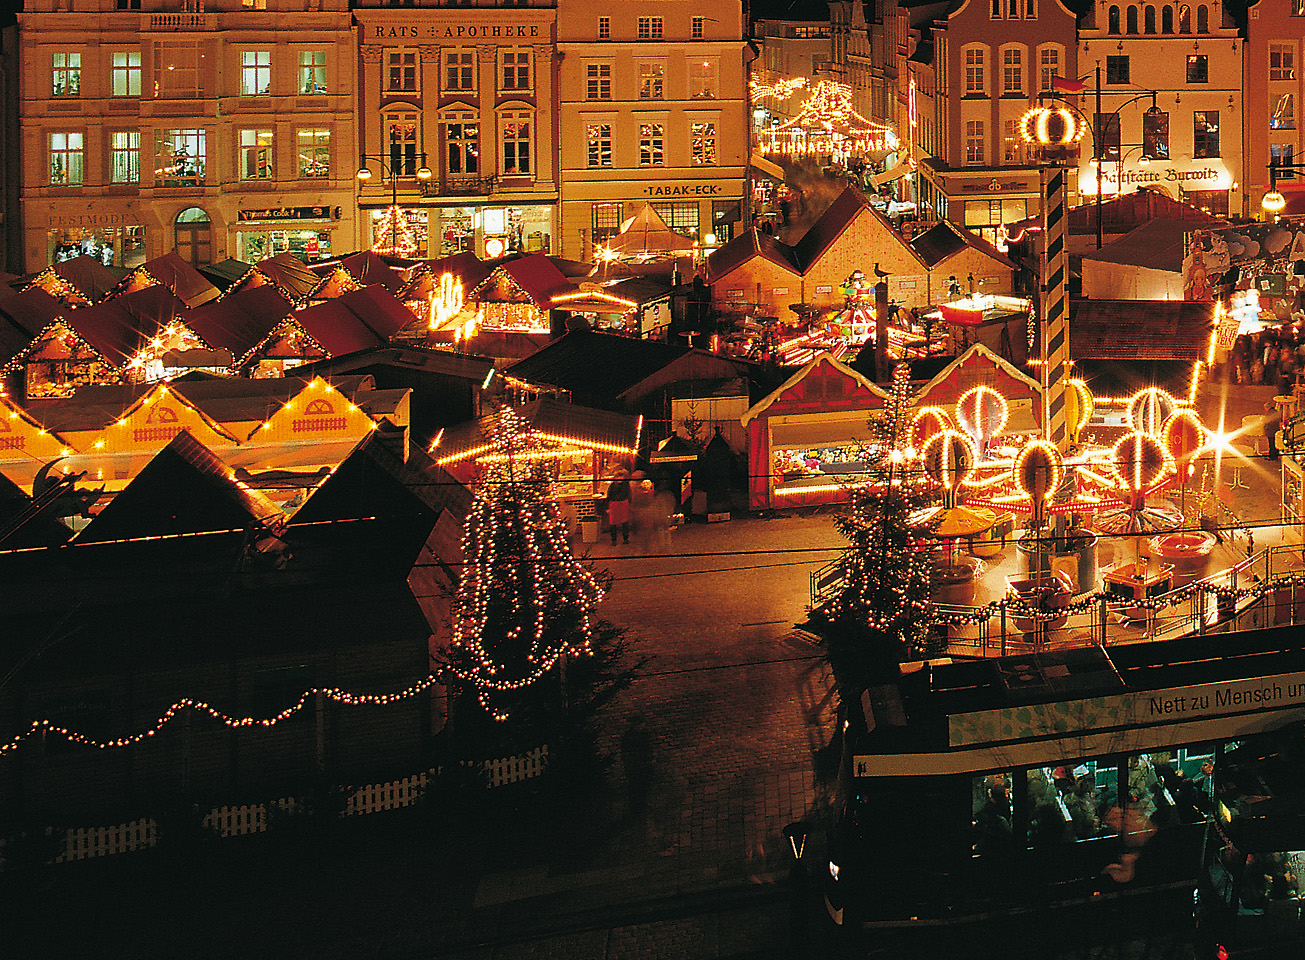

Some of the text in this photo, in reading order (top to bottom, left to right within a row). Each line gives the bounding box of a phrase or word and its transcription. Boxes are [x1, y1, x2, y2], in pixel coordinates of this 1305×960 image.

[375, 25, 539, 37] RATS APOTHEKE
[759, 138, 902, 154] WEIHNACHTSMARKT
[1098, 167, 1218, 185] Gatstätte Burwitz
[1150, 693, 1187, 715] Nett
[1191, 696, 1210, 710] zu
[1216, 683, 1281, 707] Mensch
